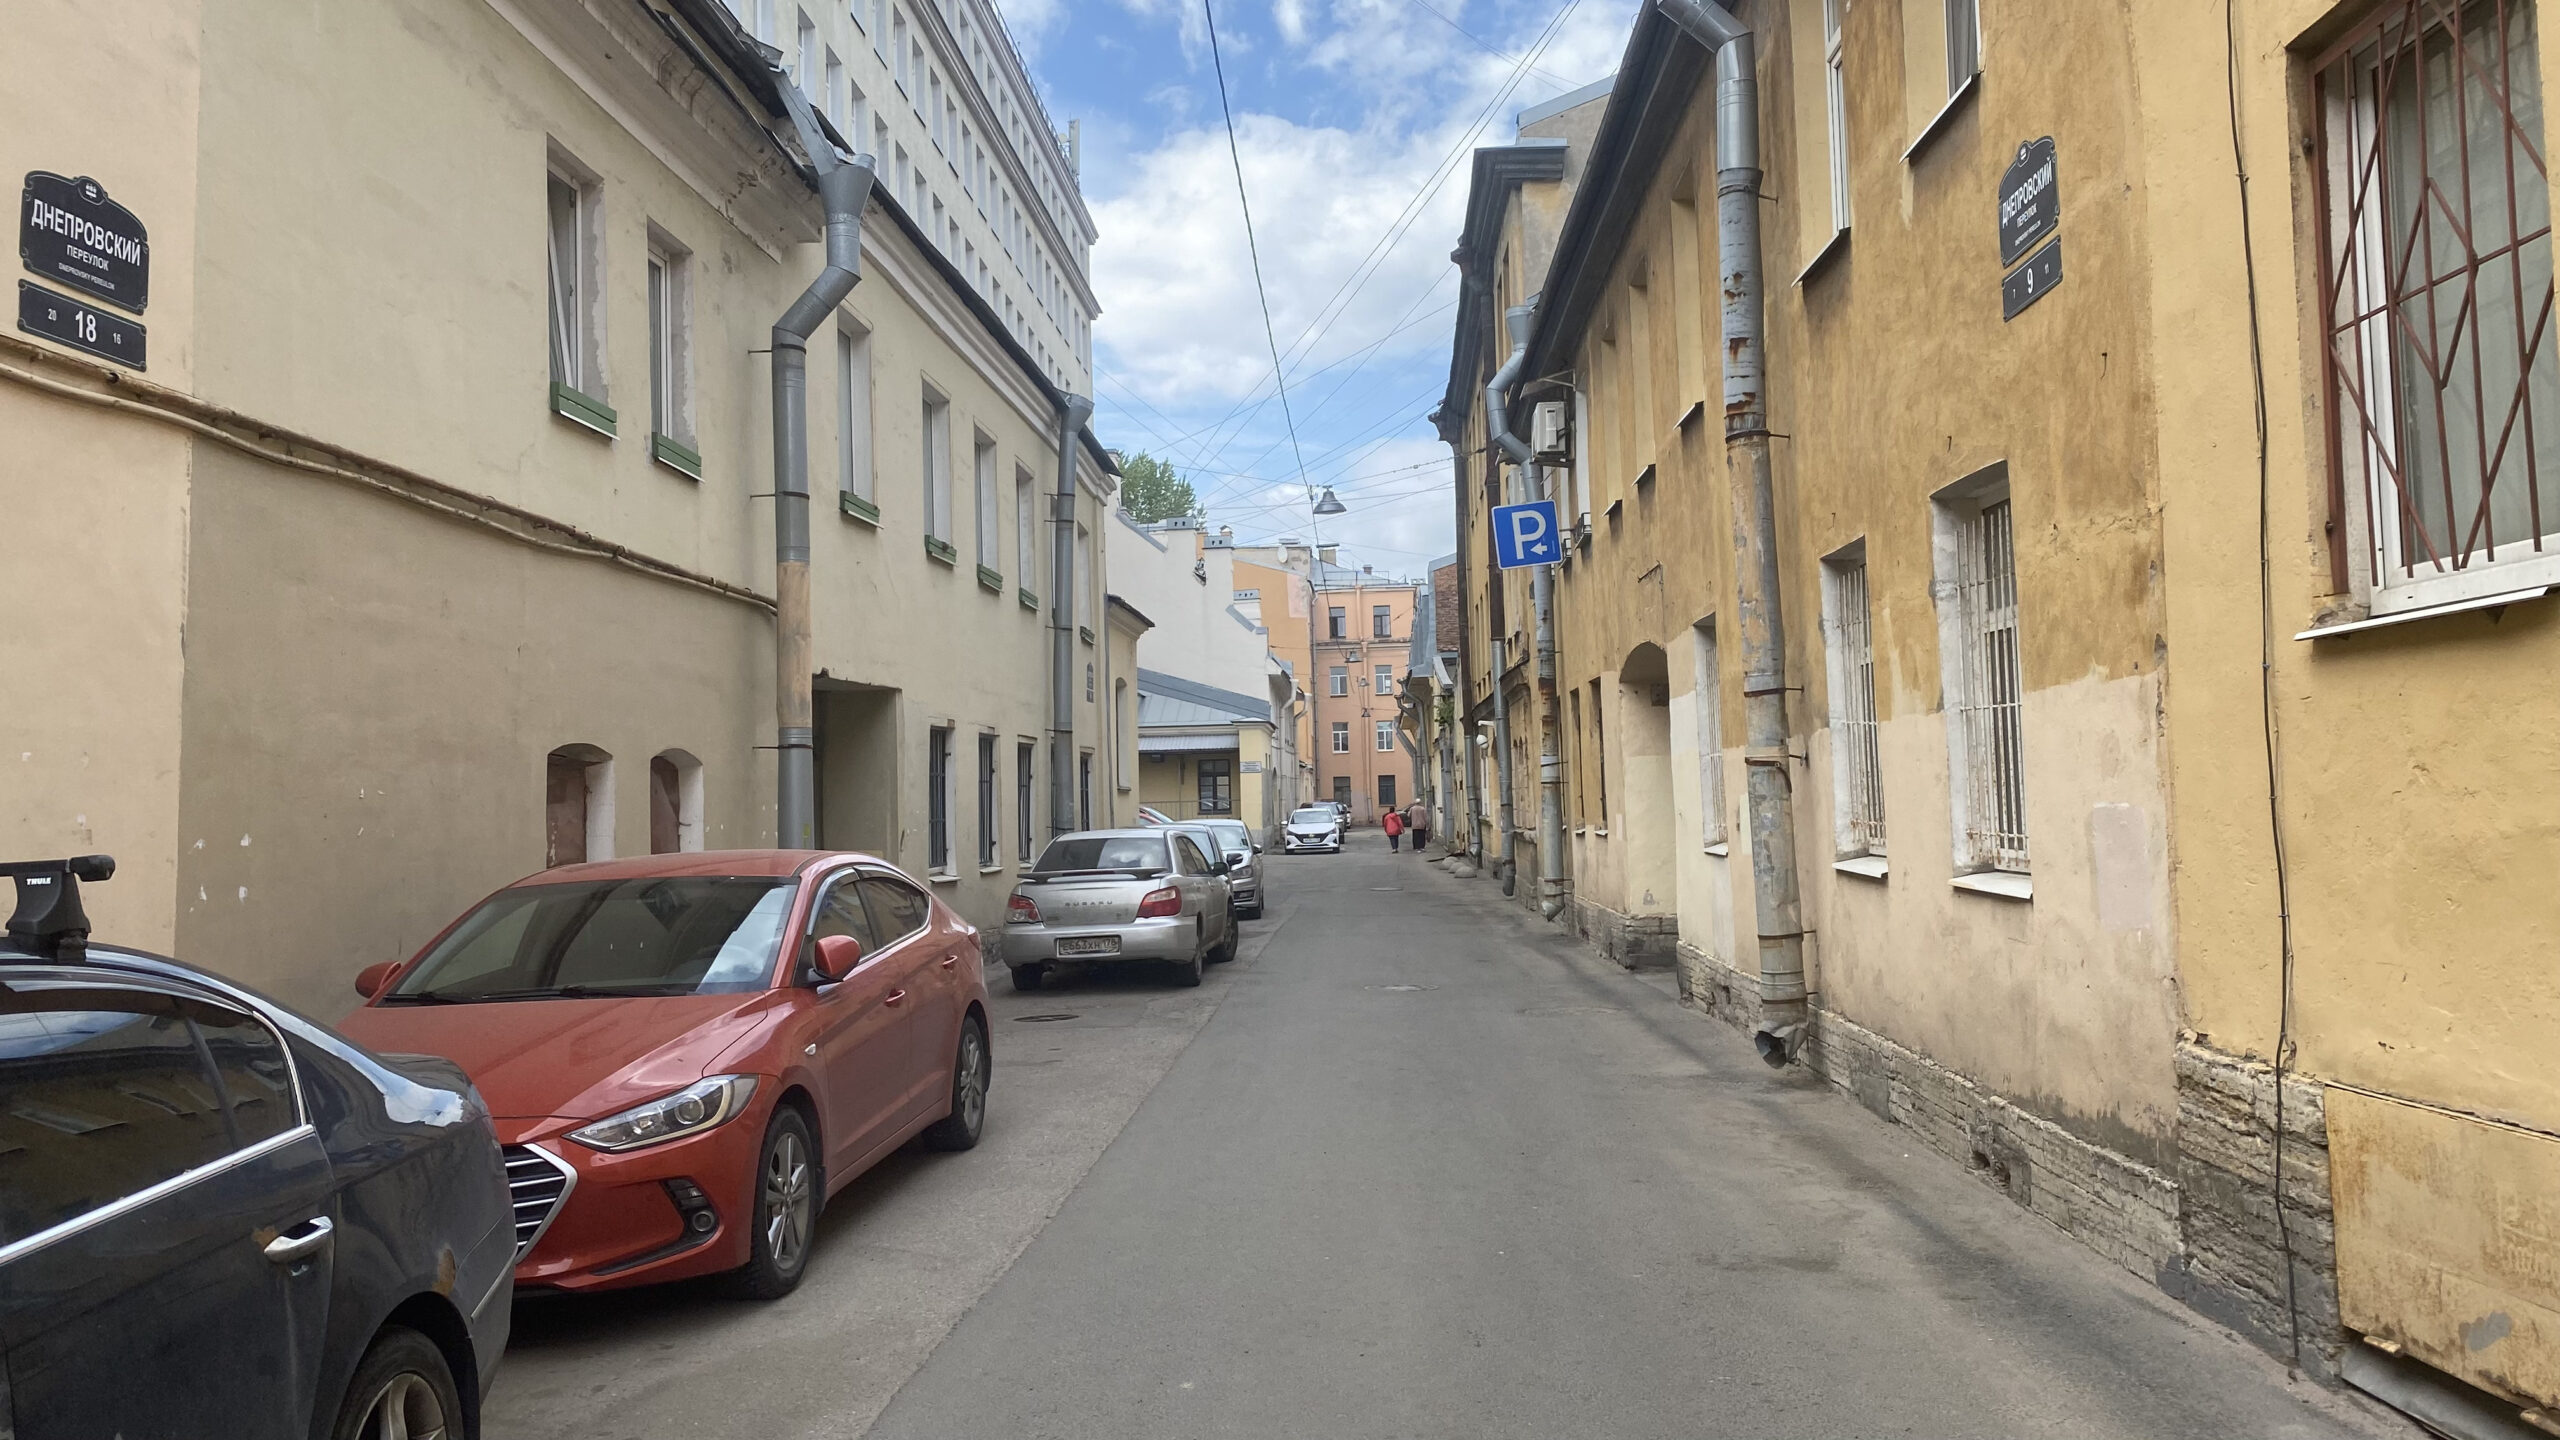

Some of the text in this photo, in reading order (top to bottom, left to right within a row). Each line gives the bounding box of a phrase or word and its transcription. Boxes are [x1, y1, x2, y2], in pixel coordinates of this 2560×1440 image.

[2002, 157, 2053, 229] ДНЕПРОВСКИЙ
[31, 198, 141, 266] ДНЕПРОВСКИЙ
[66, 244, 109, 271] ПЕРЕУЛОК
[2027, 267, 2034, 294] 9
[48, 308, 121, 345] 20 18 16
[1511, 509, 1546, 560] P
[26, 877, 52, 886] THULE
